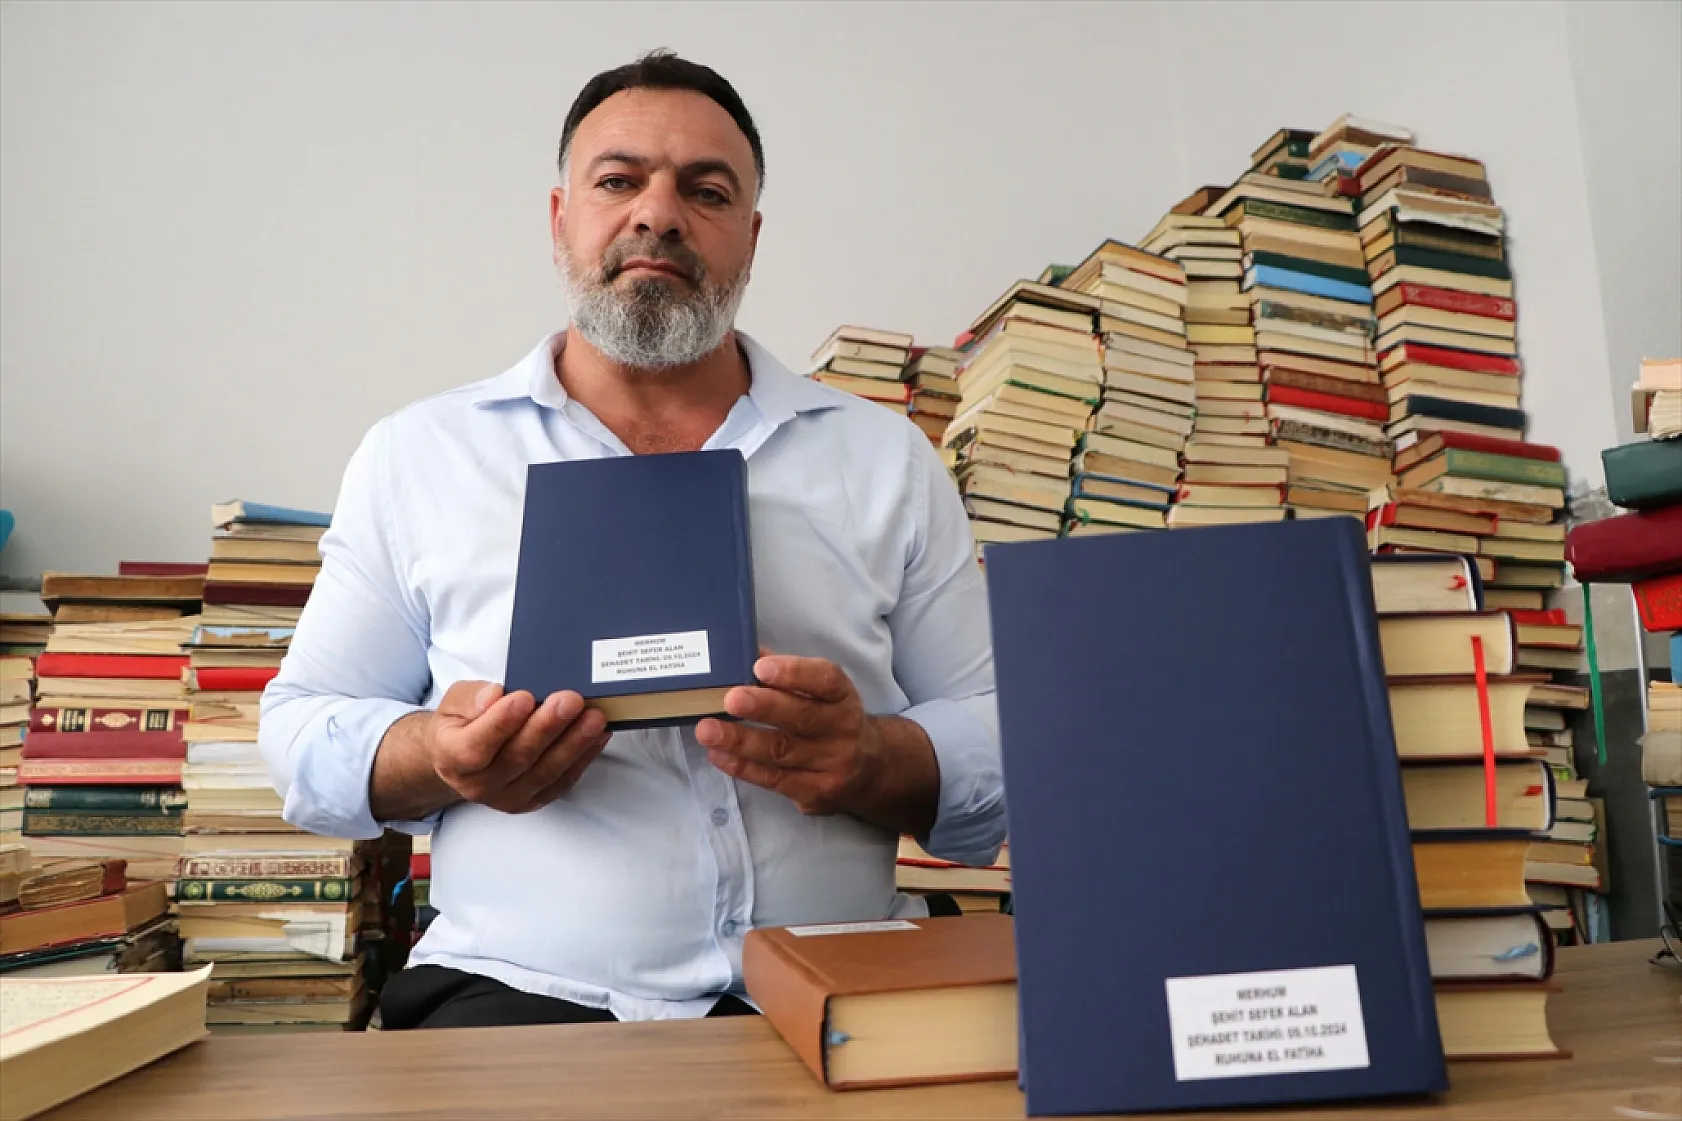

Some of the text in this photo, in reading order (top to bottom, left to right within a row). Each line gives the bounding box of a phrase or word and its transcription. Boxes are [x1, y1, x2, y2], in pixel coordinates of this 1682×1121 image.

[1236, 985, 1288, 1001] MERHUM
[1248, 1006, 1284, 1022] SEFER
[1288, 1003, 1318, 1018] ALAN
[1214, 1051, 1263, 1066] RUHUNA
[1267, 1049, 1281, 1062] EL
